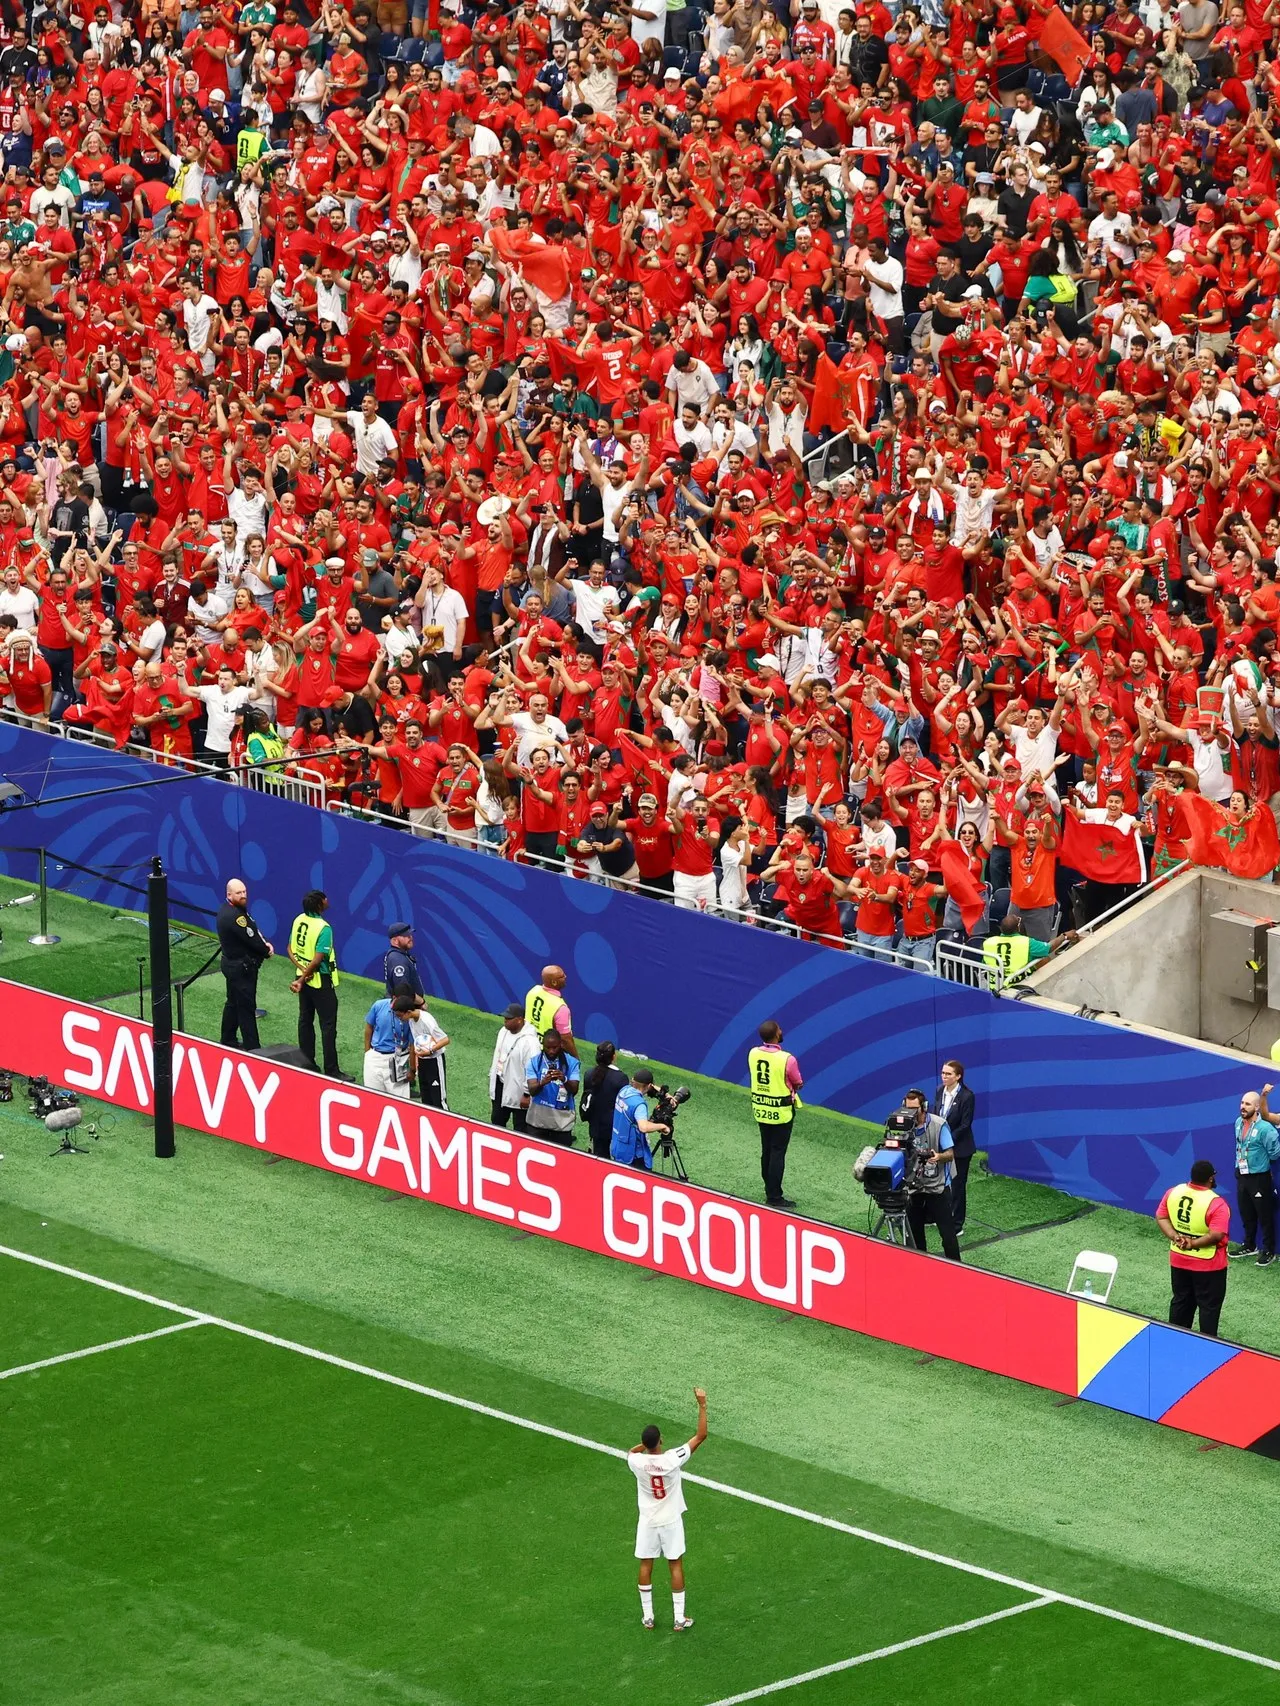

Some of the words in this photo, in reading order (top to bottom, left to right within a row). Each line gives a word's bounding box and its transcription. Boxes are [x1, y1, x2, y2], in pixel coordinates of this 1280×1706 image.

[306, 156, 328, 164] CANADA
[608, 360, 621, 380] 2
[321, 1088, 561, 1232] GAMES
[603, 1173, 845, 1310] GROUP
[650, 1475, 667, 1500] 8
